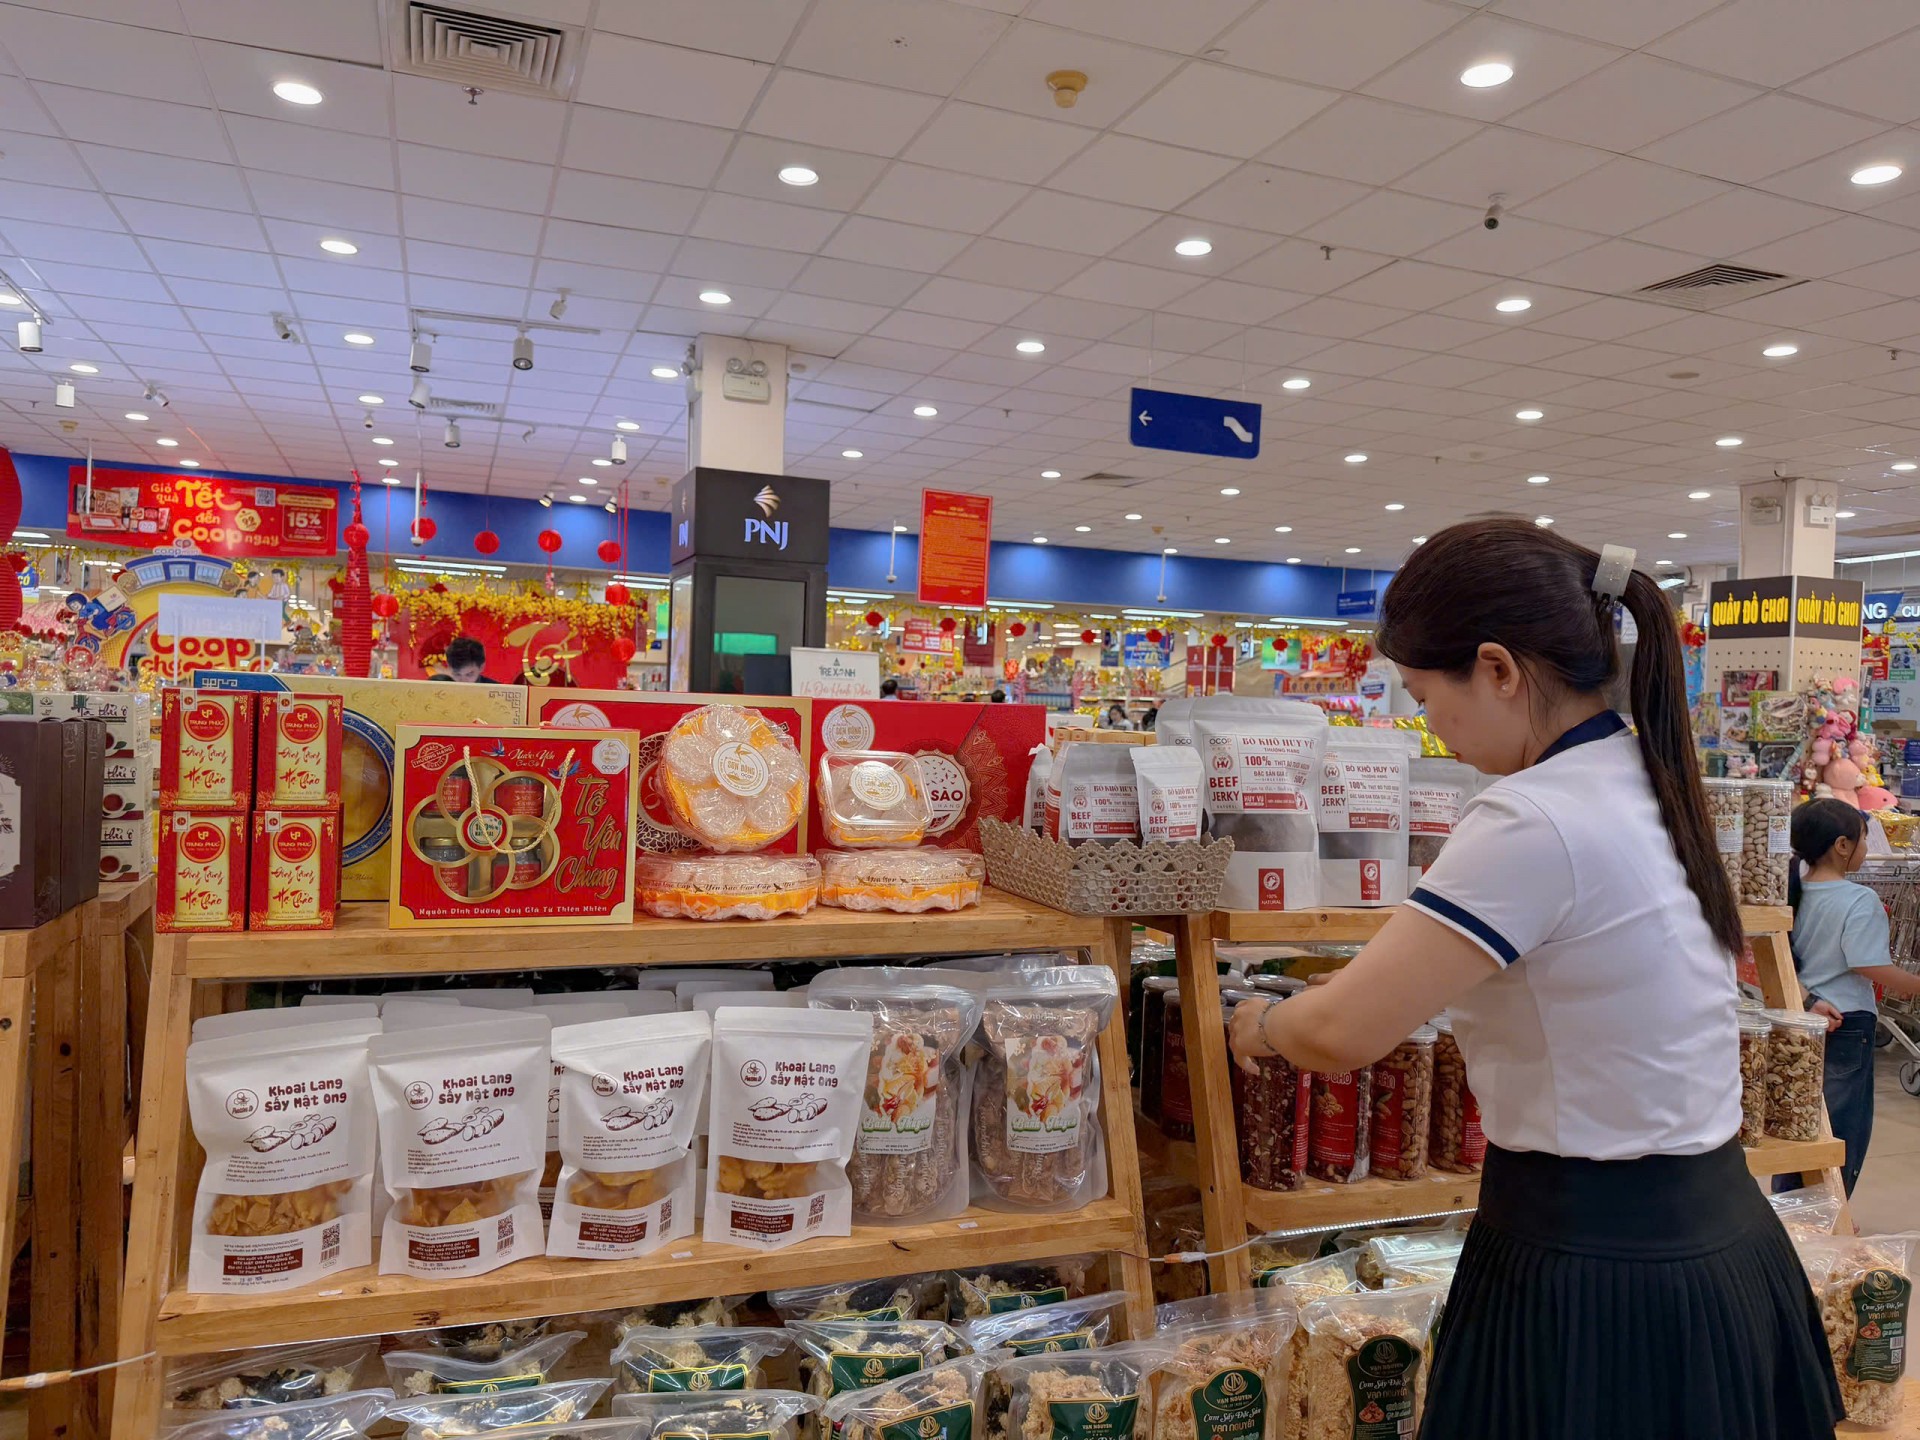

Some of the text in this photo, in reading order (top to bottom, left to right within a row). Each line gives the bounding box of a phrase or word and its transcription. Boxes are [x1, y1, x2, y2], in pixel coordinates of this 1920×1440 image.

[175, 480, 242, 511] Tết
[195, 509, 221, 525] đến
[287, 512, 321, 528] 15%
[173, 519, 242, 550] Co.op
[244, 534, 280, 547] ngay
[744, 518, 789, 550] PNJ
[1712, 590, 1789, 627] QUẦY ĐỒ CHƠI
[1797, 590, 1859, 627] QUẦY ĐỒ CHƠI
[1259, 737, 1280, 746] KHÔ
[1283, 738, 1302, 747] HUY
[1245, 756, 1272, 766] 100%
[1357, 765, 1372, 773] KHÔ
[1209, 776, 1239, 788] BEEF
[1349, 781, 1367, 790] 100%
[576, 774, 610, 817] Tổ
[931, 786, 964, 801] SÀO
[1212, 790, 1240, 802] JERKY
[1321, 785, 1345, 795] BEEF
[1094, 798, 1113, 806] 100%
[1321, 798, 1346, 807] JERKY
[1071, 811, 1091, 820] BEEF
[1149, 816, 1168, 824] BEEF
[1071, 822, 1092, 830] JERKY
[1149, 826, 1168, 834] JERKY
[577, 814, 623, 866] Yến
[623, 1065, 684, 1082] Khoai Lang
[775, 1061, 836, 1075] Khoai Lang
[443, 1073, 512, 1090] Khoai Lang
[622, 1079, 684, 1094] Sấy Mật Ong
[770, 1071, 838, 1088] Sấy Mật Ong
[269, 1078, 343, 1097] Khoai Lang
[265, 1092, 347, 1112] Sấy Mật Ong
[438, 1087, 515, 1104] Sấy Mật Ong
